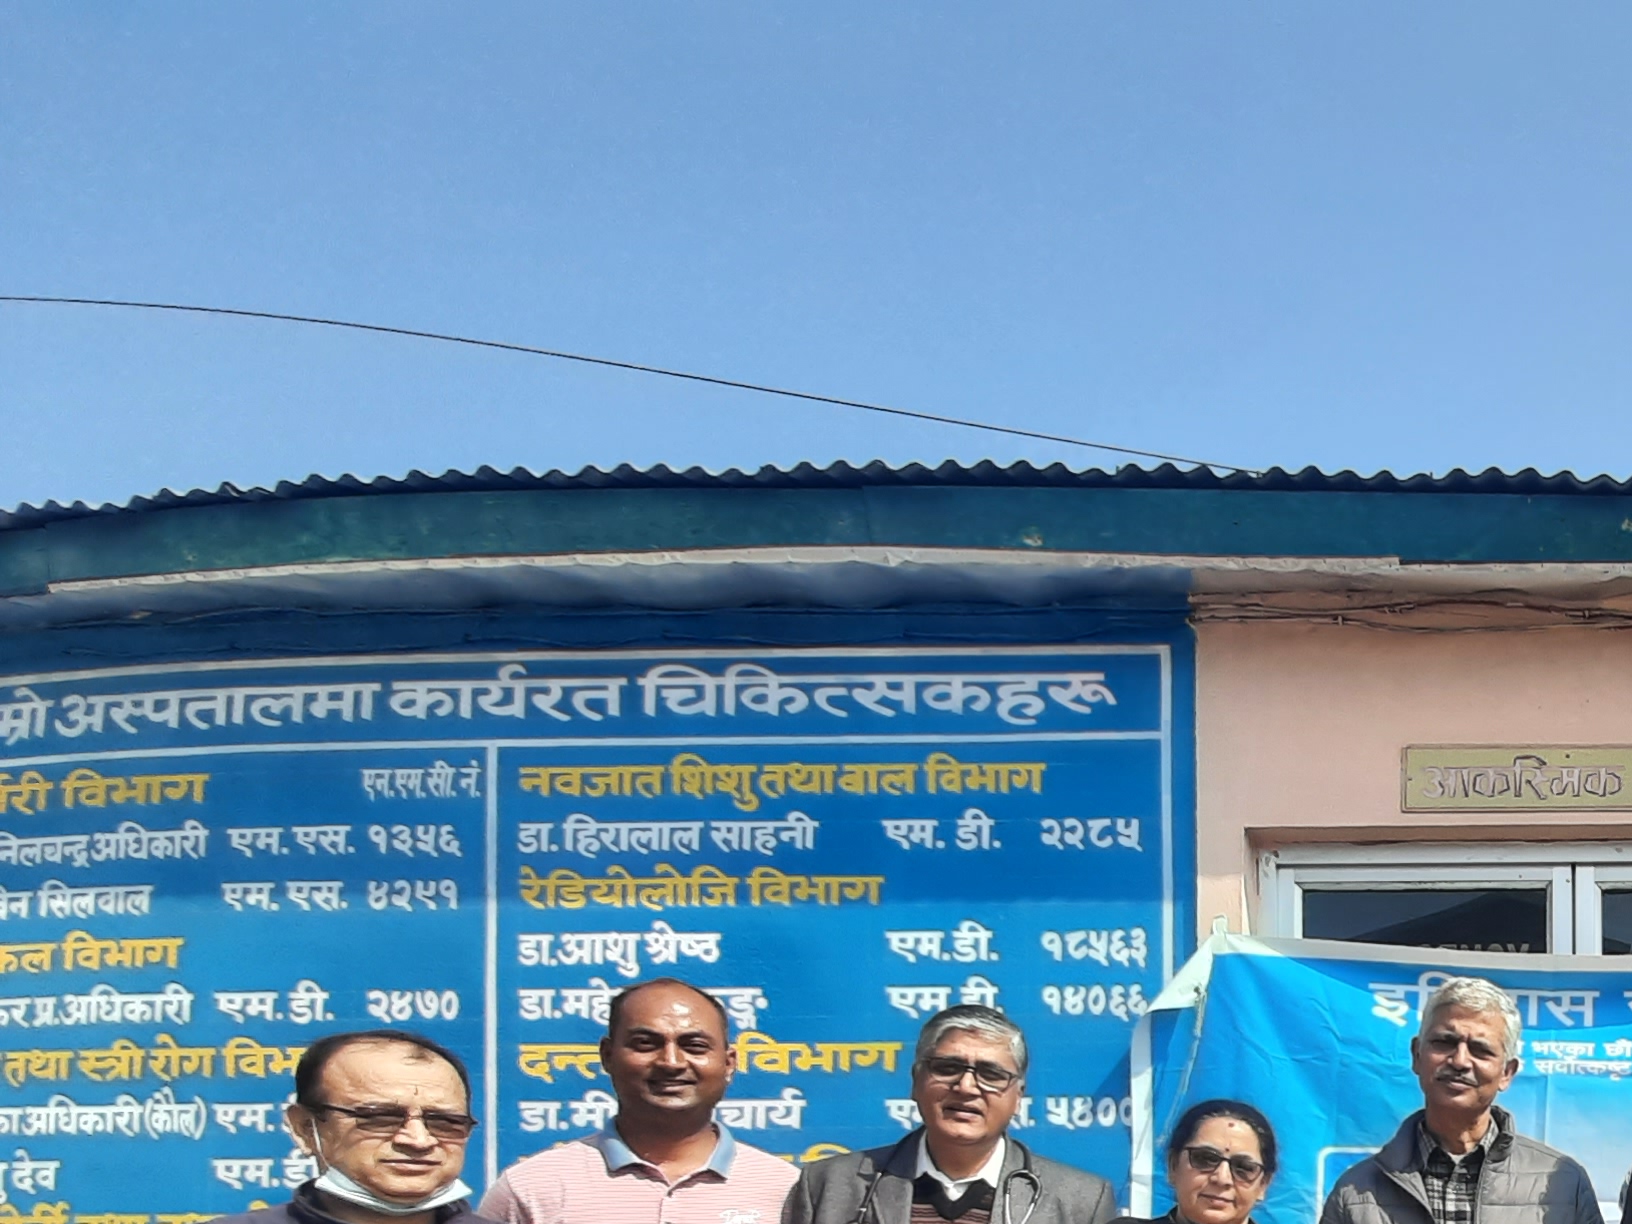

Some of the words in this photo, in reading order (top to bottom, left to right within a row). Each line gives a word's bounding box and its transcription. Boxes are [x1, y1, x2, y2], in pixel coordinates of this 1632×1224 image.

[54, 682, 381, 738] अस्पतालमा
[391, 664, 626, 721] कार्यरत
[637, 662, 1117, 725] चिकित्सकहरू
[61, 768, 211, 809] विभाग
[518, 766, 664, 798] नवजात
[668, 752, 761, 812] शिशु
[759, 762, 837, 797] तथा
[923, 752, 1047, 795] विभाग
[91, 819, 209, 862] अधिकारी
[226, 827, 290, 858] एम.
[291, 825, 355, 856] एस.
[368, 824, 463, 858] १३५६
[562, 813, 704, 859] हिरालाल
[711, 810, 819, 856] साहनी
[881, 818, 945, 850] एम.
[955, 807, 1001, 851] डी.
[1040, 817, 1143, 853] २२८५
[37, 879, 154, 919] सिलवाल
[221, 881, 279, 912] एम.
[286, 880, 348, 912] एस.
[746, 866, 885, 908] विभाग
[61, 930, 184, 971] विभाग
[1040, 927, 1148, 969] १८५६३
[214, 990, 284, 1024] एम.
[287, 979, 335, 1024] डी.
[366, 989, 460, 1024] २४७०
[4, 1048, 73, 1088] तथा
[77, 1039, 146, 1081] स्त्री
[148, 1033, 217, 1082] रोग
[733, 1031, 902, 1074] विभाग
[23, 1094, 145, 1136] अधिकारी
[12, 1149, 60, 1194] देव
[283, 1149, 319, 1189] डी
